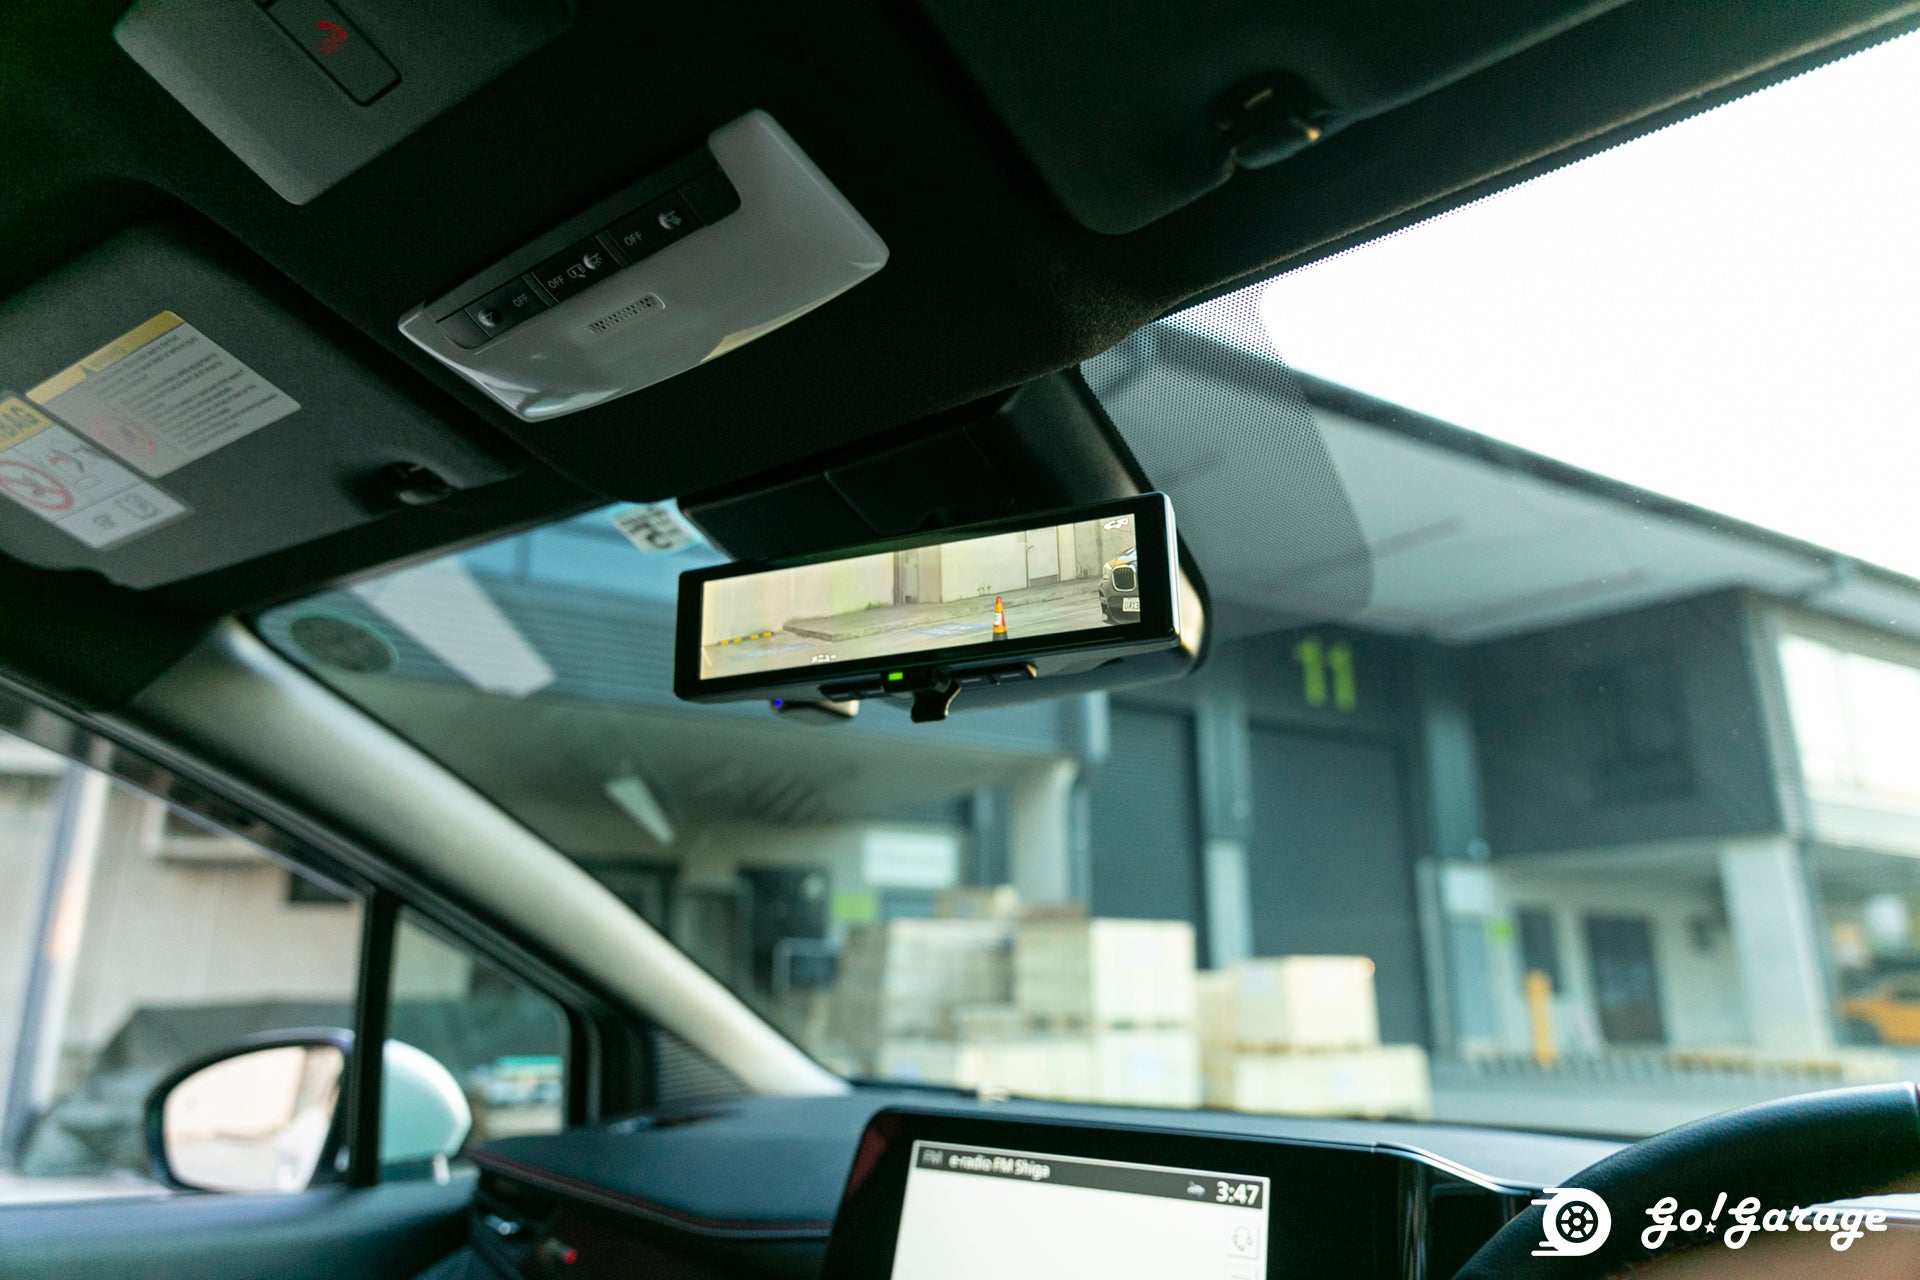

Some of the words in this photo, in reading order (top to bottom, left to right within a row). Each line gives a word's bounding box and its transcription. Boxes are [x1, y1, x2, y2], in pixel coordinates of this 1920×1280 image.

[624, 231, 643, 247] OFF
[548, 275, 565, 290] OFF
[512, 293, 530, 308] OFF
[1295, 638, 1357, 711] 11
[922, 1149, 944, 1166] FM
[948, 1153, 992, 1173] e-radio
[993, 1156, 1014, 1175] FM
[1015, 1158, 1051, 1181] Shiga
[1215, 1180, 1260, 1206] 3:47
